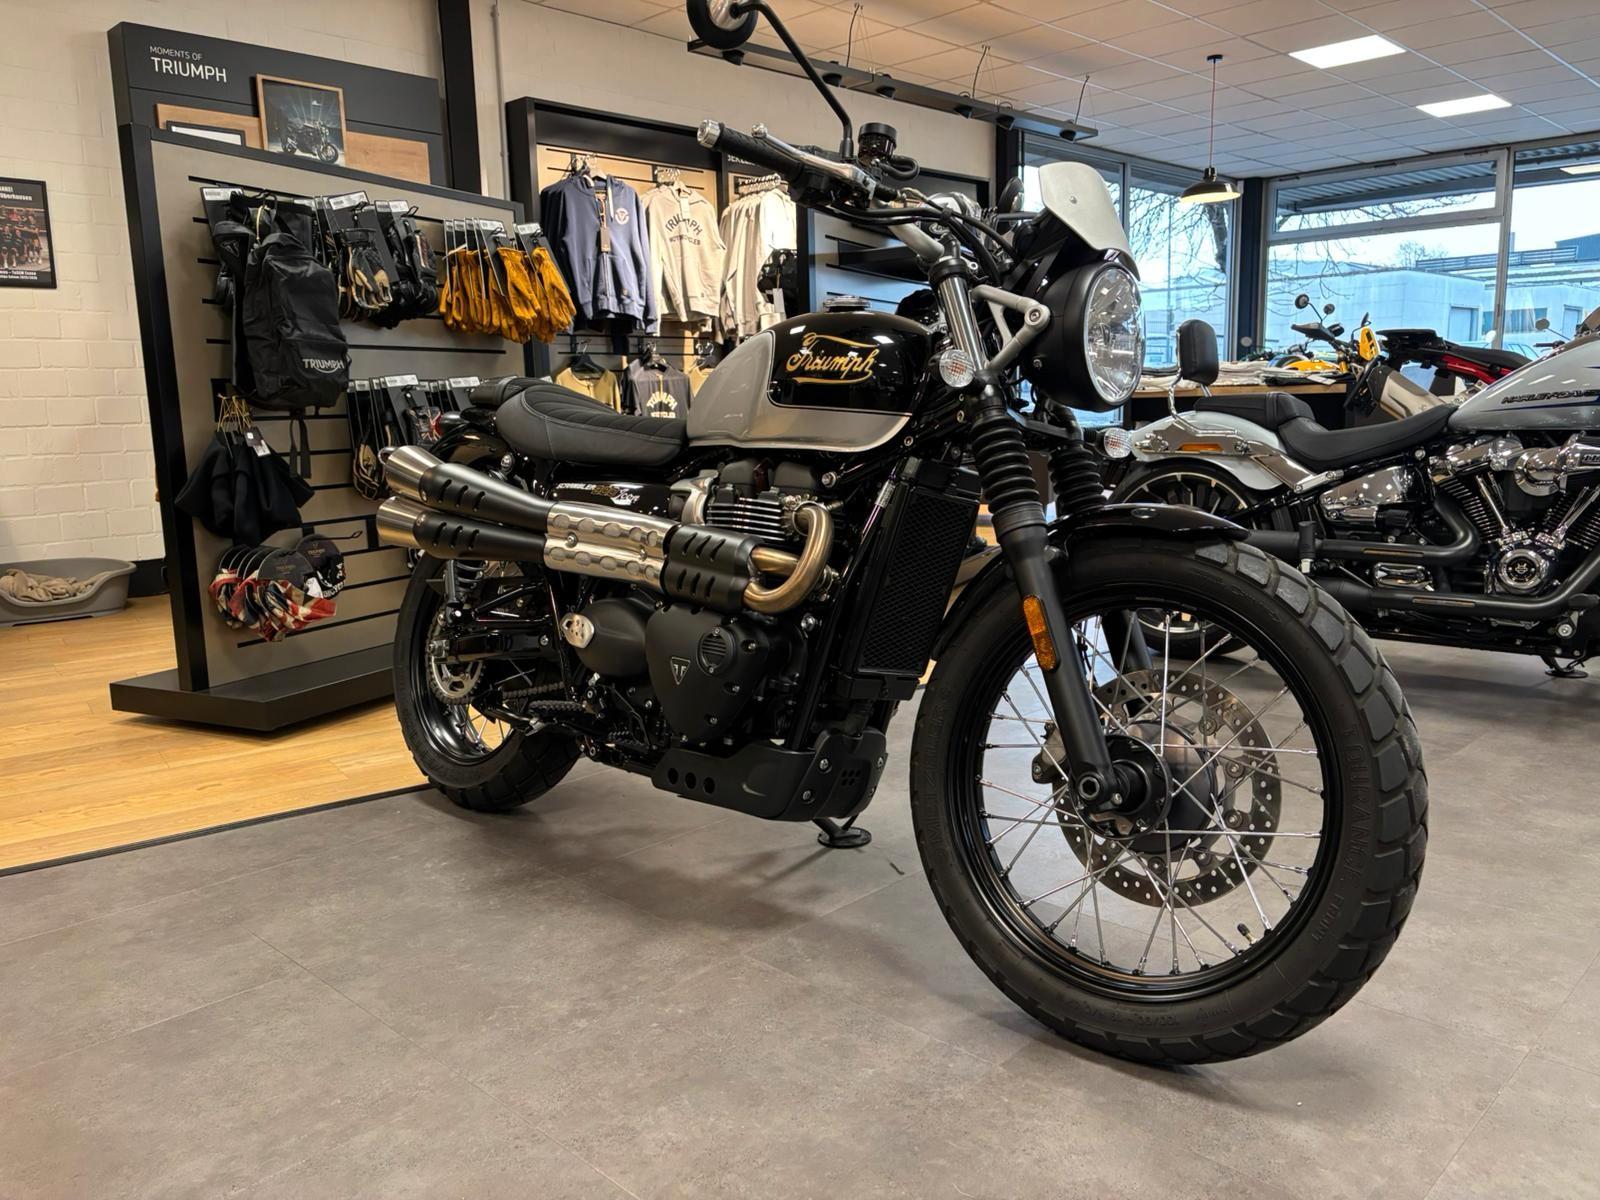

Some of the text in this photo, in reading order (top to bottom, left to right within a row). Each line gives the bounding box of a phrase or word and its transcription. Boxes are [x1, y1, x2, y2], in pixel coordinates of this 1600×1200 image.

[149, 46, 203, 61] MOMENTS OF
[150, 56, 227, 83] TRIUMPH
[302, 358, 345, 373] TRIUMPH
[786, 332, 880, 384] Triumph
